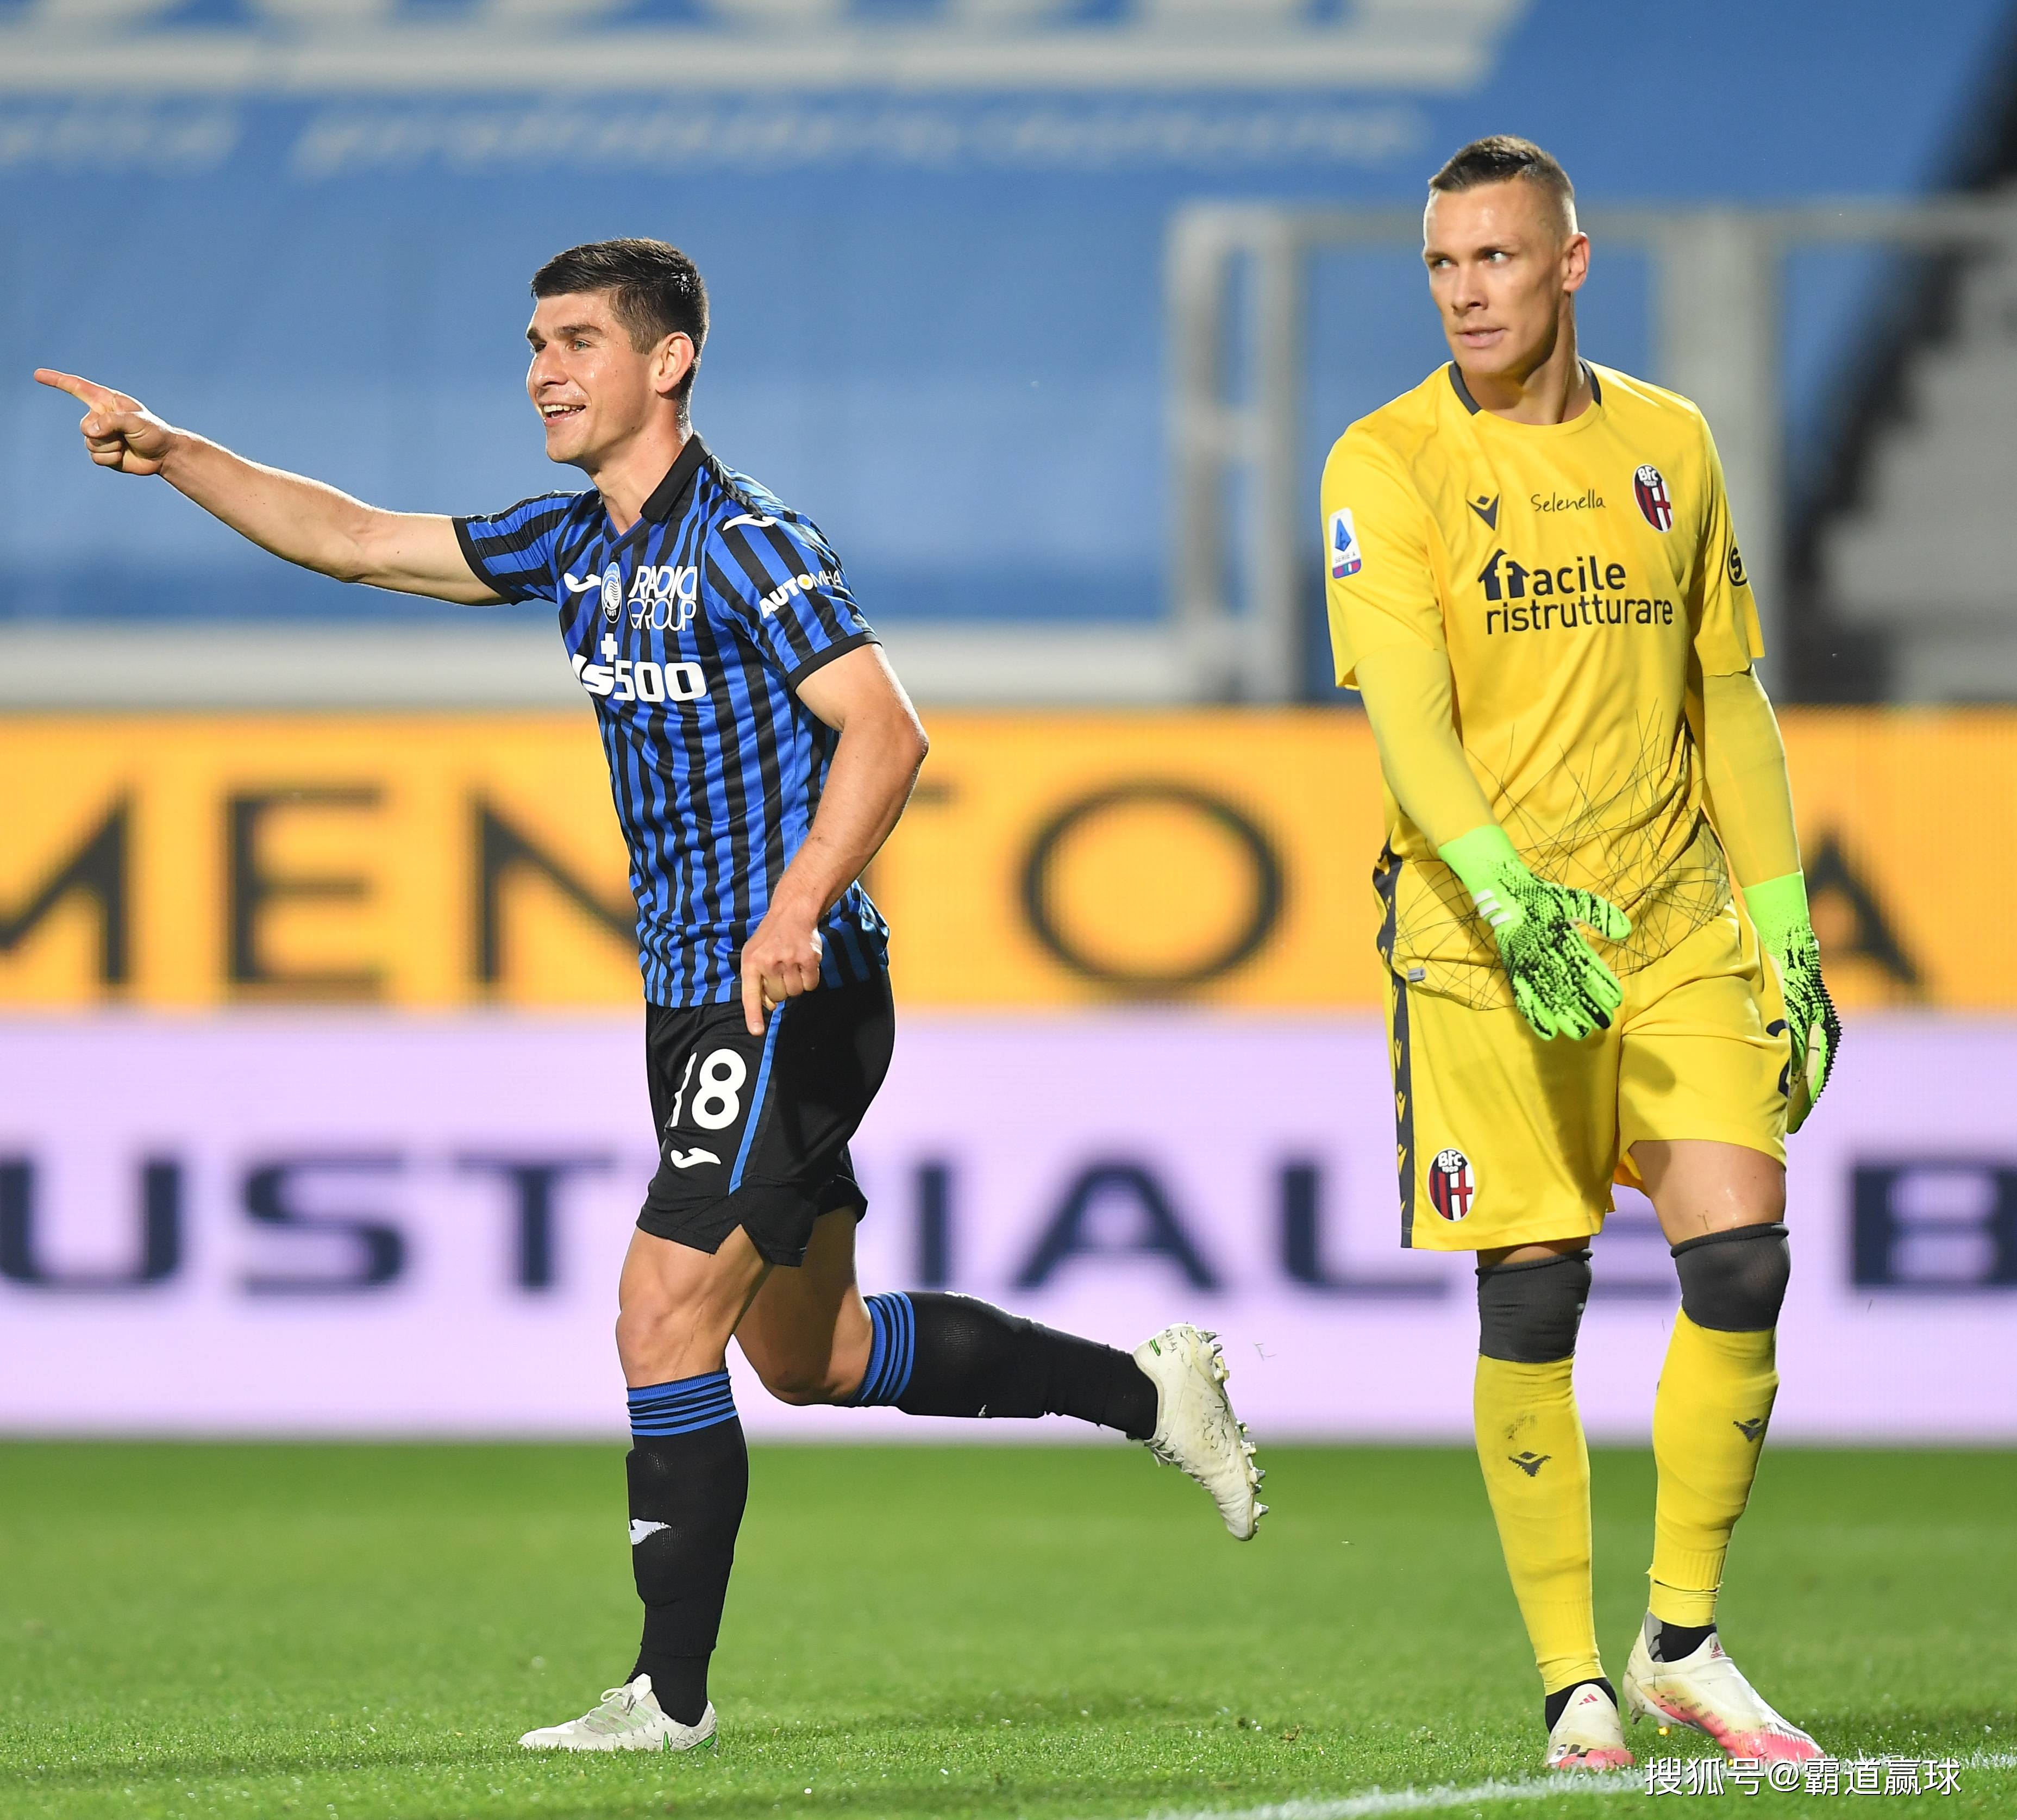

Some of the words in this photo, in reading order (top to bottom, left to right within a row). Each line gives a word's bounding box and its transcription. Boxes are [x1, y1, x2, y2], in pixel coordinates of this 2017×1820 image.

[1637, 466, 1659, 481] BFC
[1530, 489, 1606, 512] Selenella
[628, 565, 698, 601] RADICI
[1478, 548, 1627, 601] facile
[627, 597, 697, 632] GROUP
[1486, 593, 1674, 635] ristrutturare
[1438, 1150, 1462, 1167] BFC
